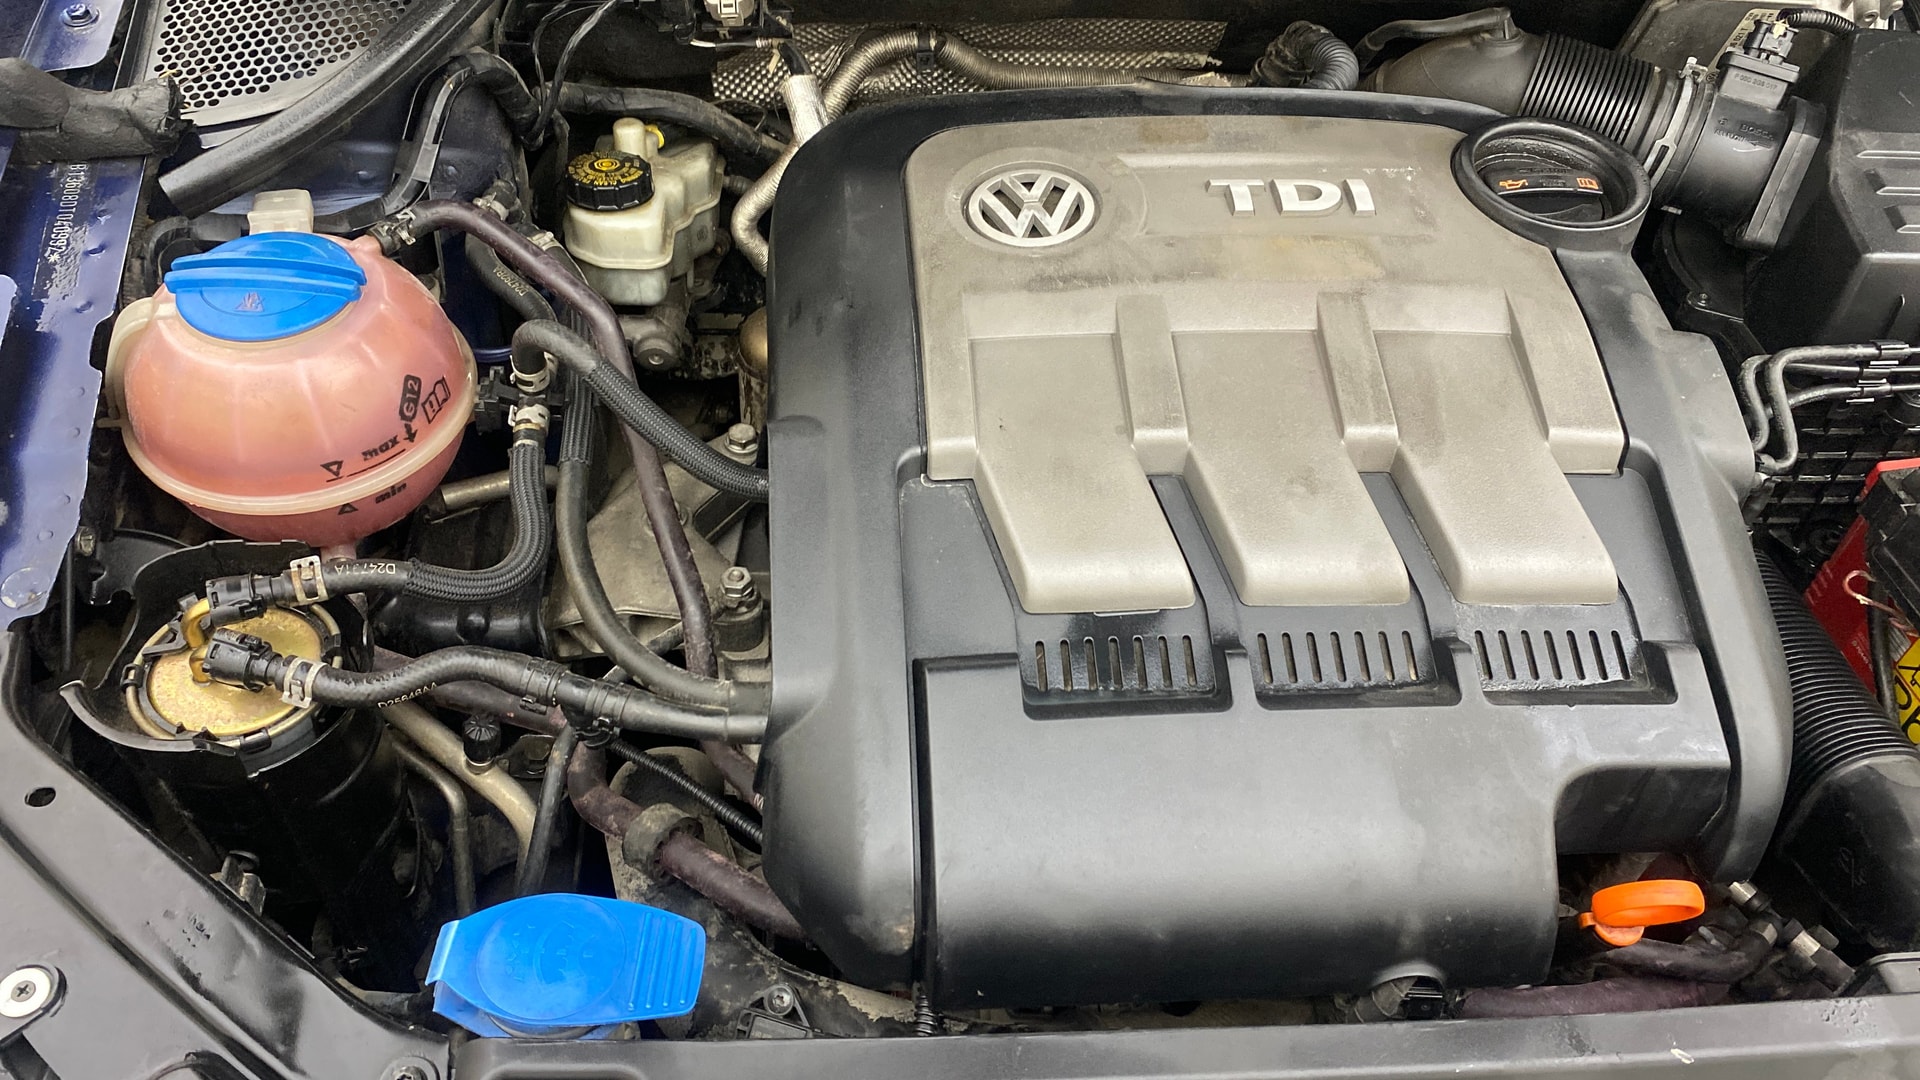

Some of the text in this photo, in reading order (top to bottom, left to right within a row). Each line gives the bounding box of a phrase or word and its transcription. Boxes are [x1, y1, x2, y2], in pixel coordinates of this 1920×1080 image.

[968, 168, 1096, 248] VW
[1206, 178, 1377, 216] TDI
[403, 379, 419, 416] G12
[362, 435, 400, 461] max
[375, 483, 407, 504] min
